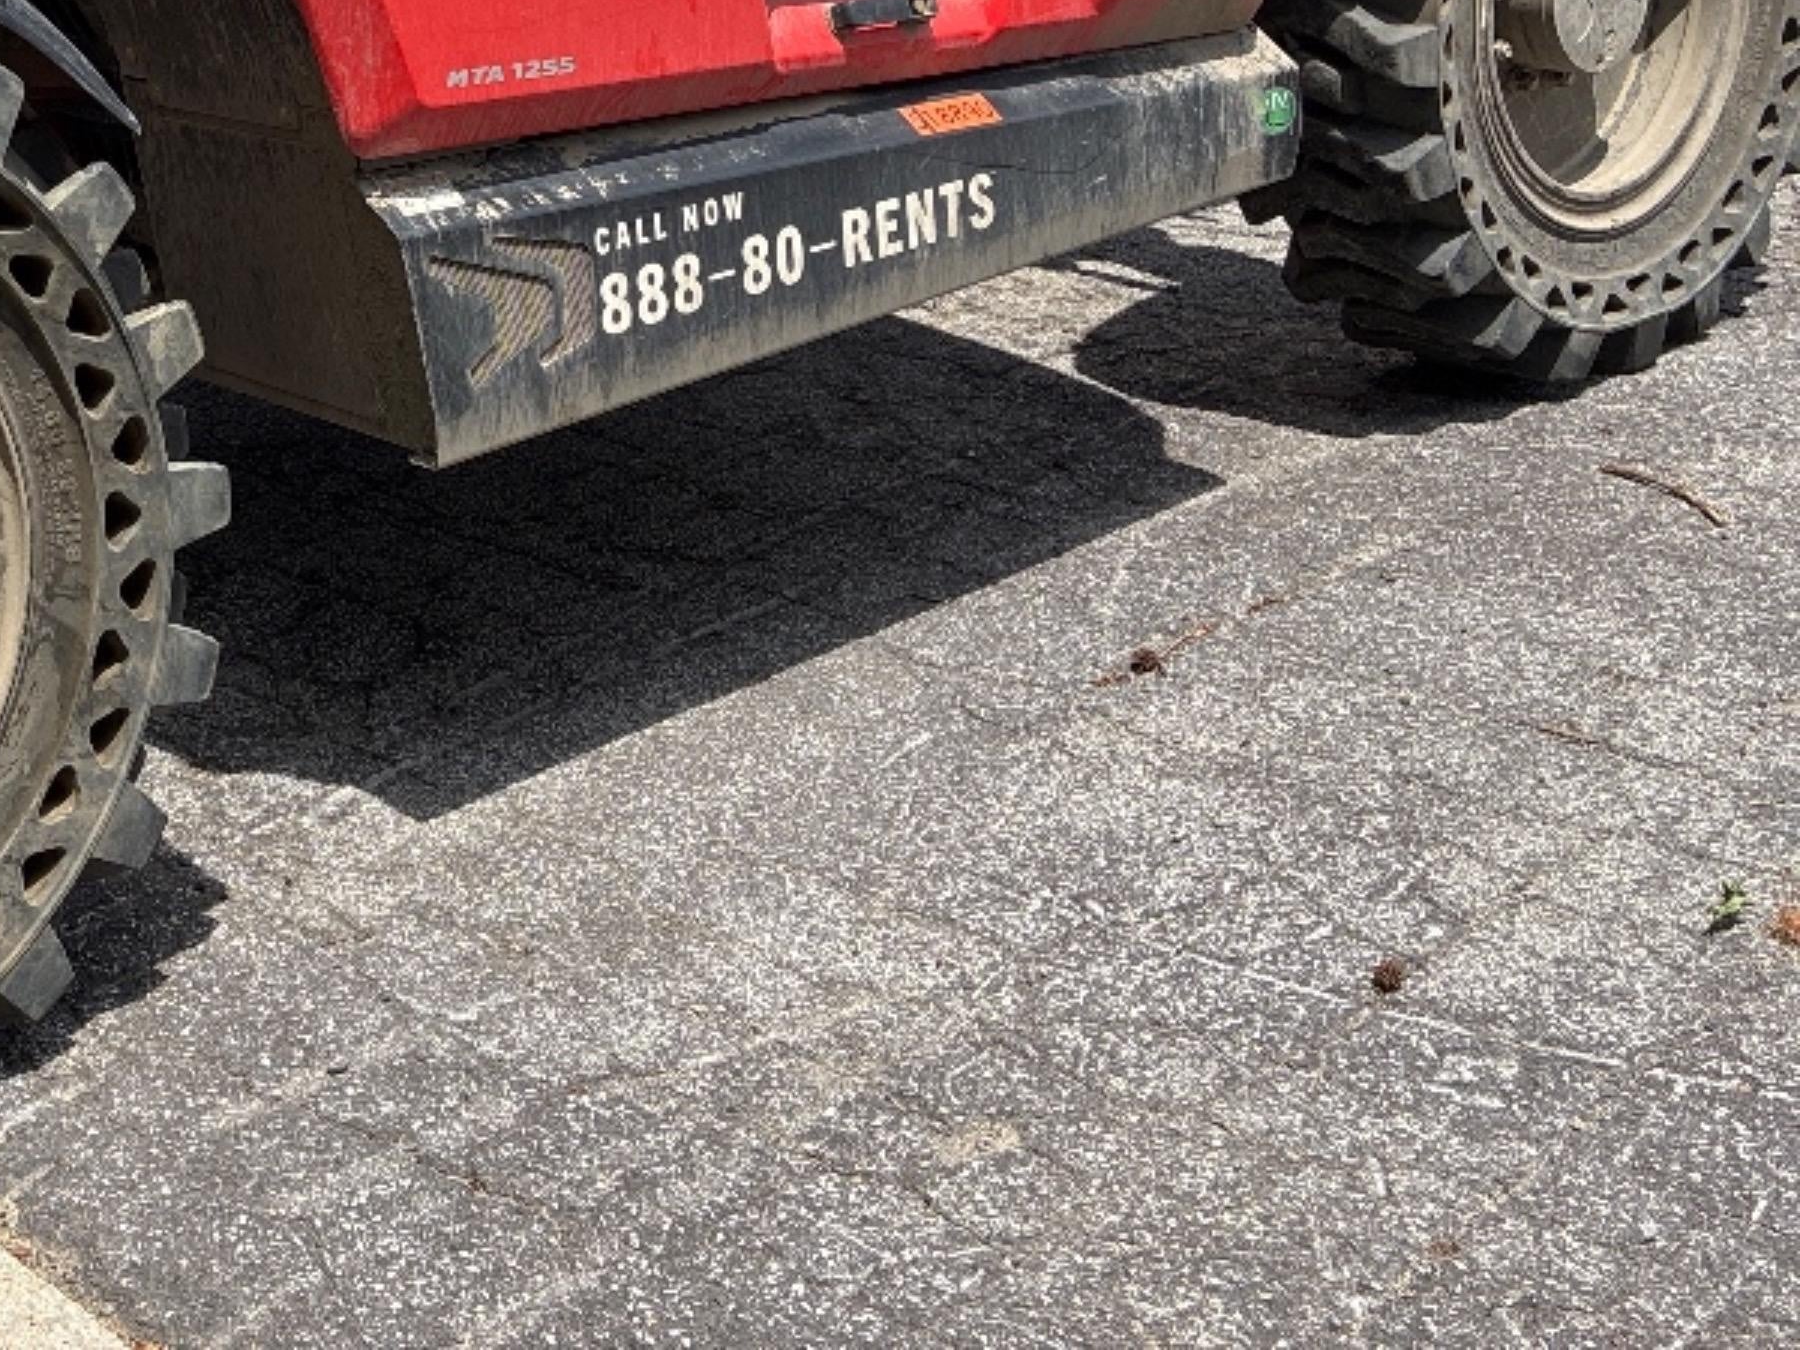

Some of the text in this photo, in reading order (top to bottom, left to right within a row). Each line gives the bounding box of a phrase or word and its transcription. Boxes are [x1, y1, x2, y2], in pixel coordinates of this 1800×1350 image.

[446, 56, 576, 88] MTA 1255
[594, 191, 744, 256] CALL NOW
[599, 172, 997, 335] 888-80-RENTS
